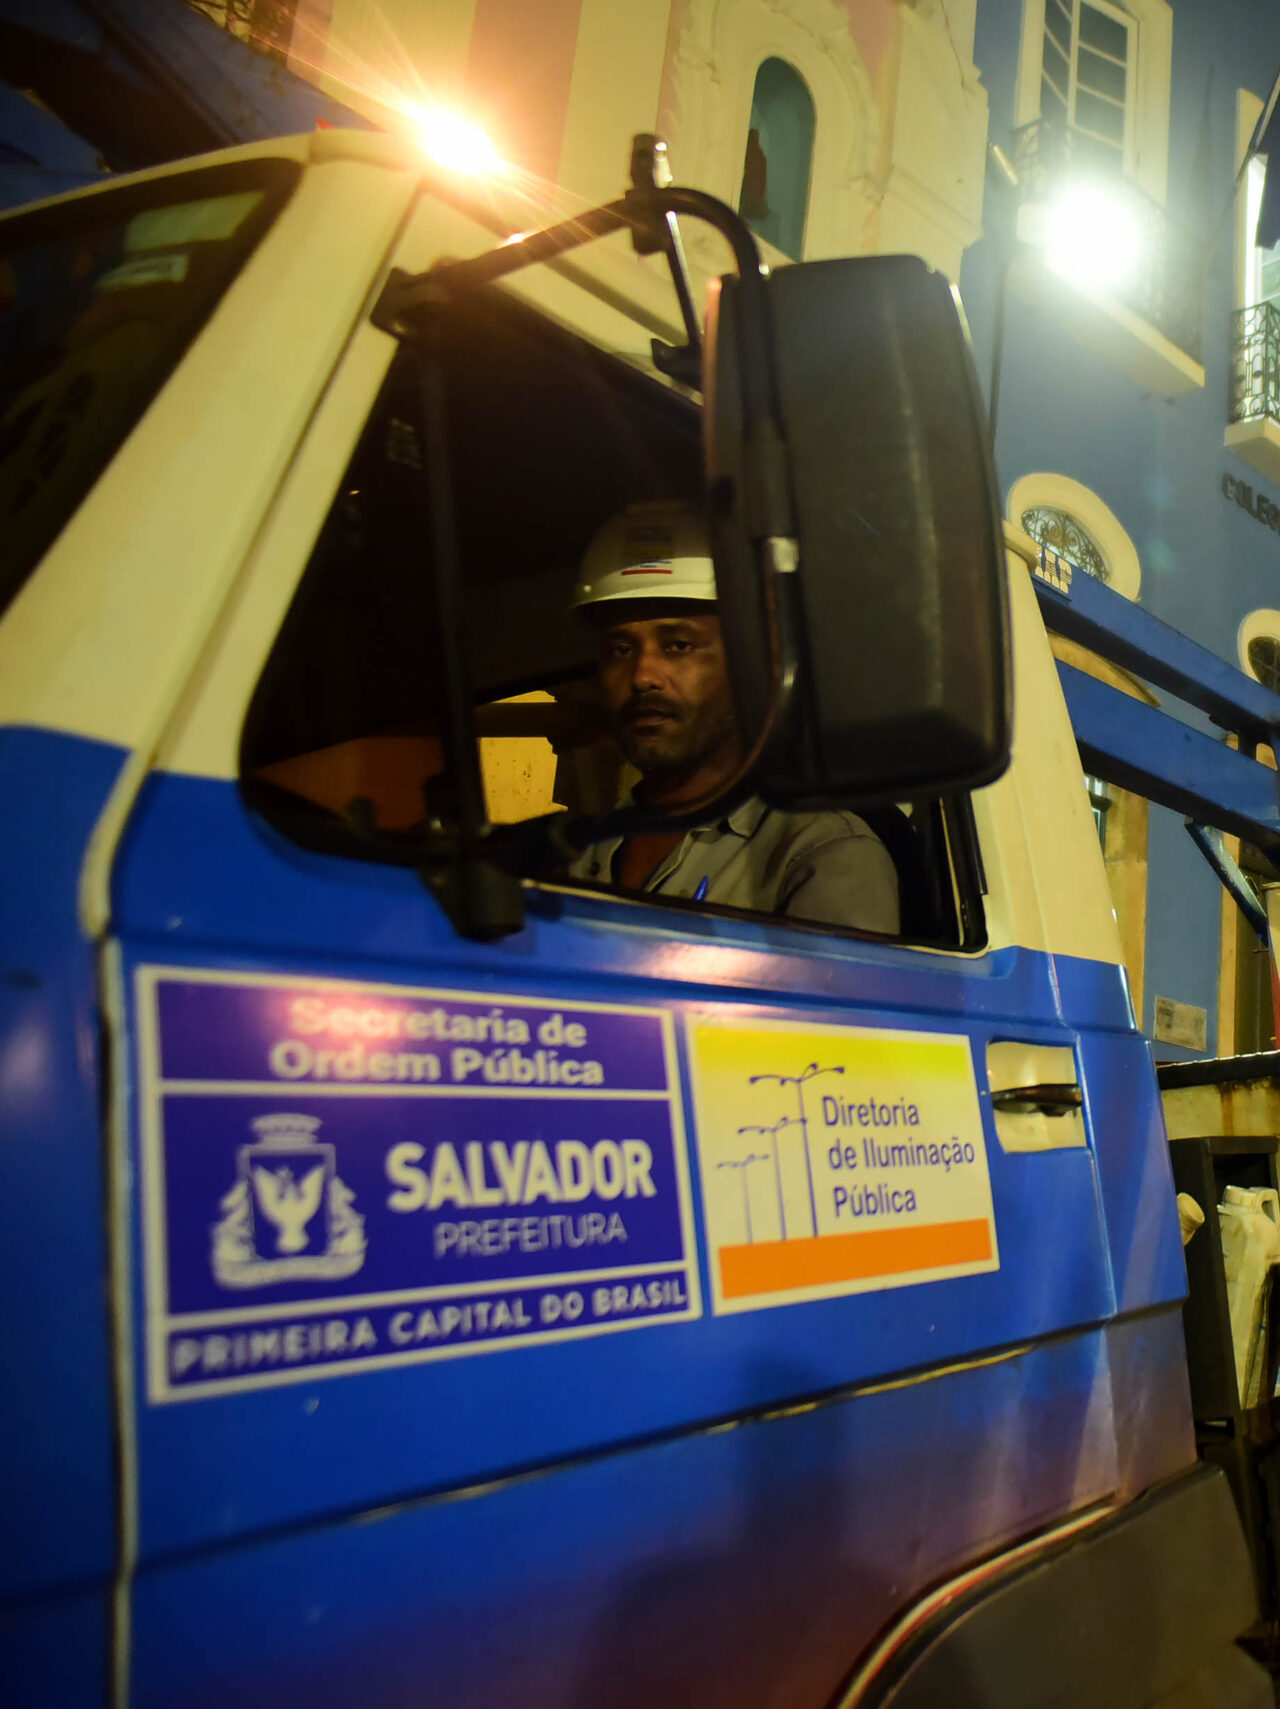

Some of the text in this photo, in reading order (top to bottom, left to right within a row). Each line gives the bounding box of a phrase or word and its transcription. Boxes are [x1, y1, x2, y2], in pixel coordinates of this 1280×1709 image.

[288, 994, 588, 1048] Secretaria de
[269, 1038, 606, 1087] Ordem Pública
[821, 1094, 921, 1128] Diretoria
[384, 1138, 657, 1214] SALVADOR
[828, 1136, 976, 1173] de Iluminação
[832, 1183, 918, 1220] Pública
[433, 1210, 629, 1260] PREFEITURA
[171, 1277, 689, 1378] PRIMEIRA CAPITAL DO BRASIL
